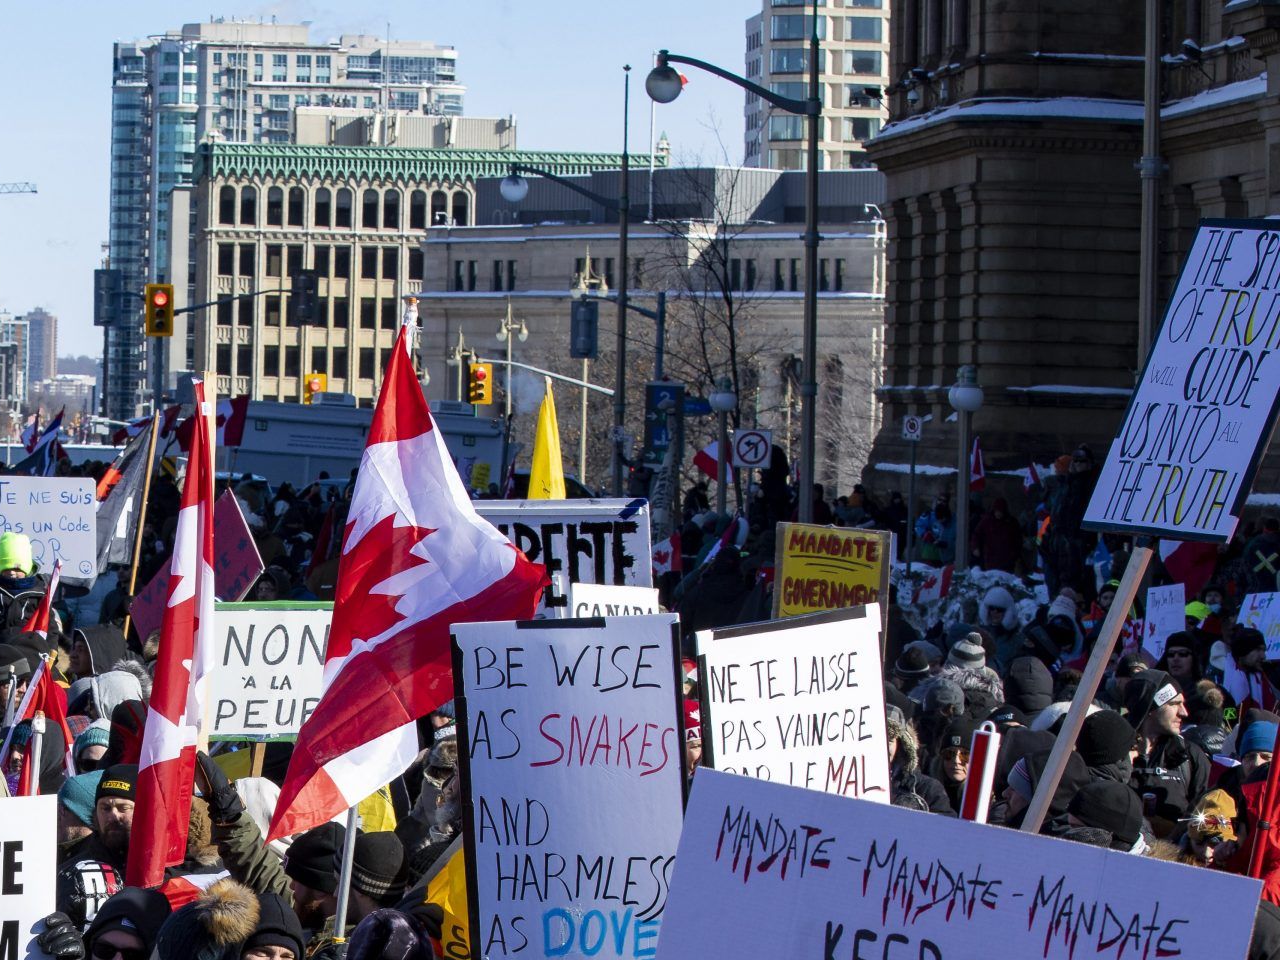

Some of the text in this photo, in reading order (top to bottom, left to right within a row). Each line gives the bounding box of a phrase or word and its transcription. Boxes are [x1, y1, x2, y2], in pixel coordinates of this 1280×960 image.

[1193, 230, 1243, 287] THE
[1169, 288, 1216, 343] OF
[1150, 346, 1270, 409] WILL GUIDE
[1120, 402, 1243, 465] US INTO ALL
[29, 492, 52, 505] NE
[1103, 460, 1239, 531] THE TRUTH
[32, 521, 53, 533] UN
[789, 529, 880, 562] MANDATE
[223, 624, 331, 667] NON
[474, 644, 662, 693] BE WISE
[270, 675, 292, 690] LA
[710, 651, 859, 704] NE TE LAISSE
[470, 708, 676, 777] AS SNAKES
[721, 705, 873, 755] PAS VAINCRE
[825, 754, 886, 797] MAL
[479, 795, 550, 847] AND
[496, 851, 677, 924] HARMLESS
[484, 914, 528, 956] AS
